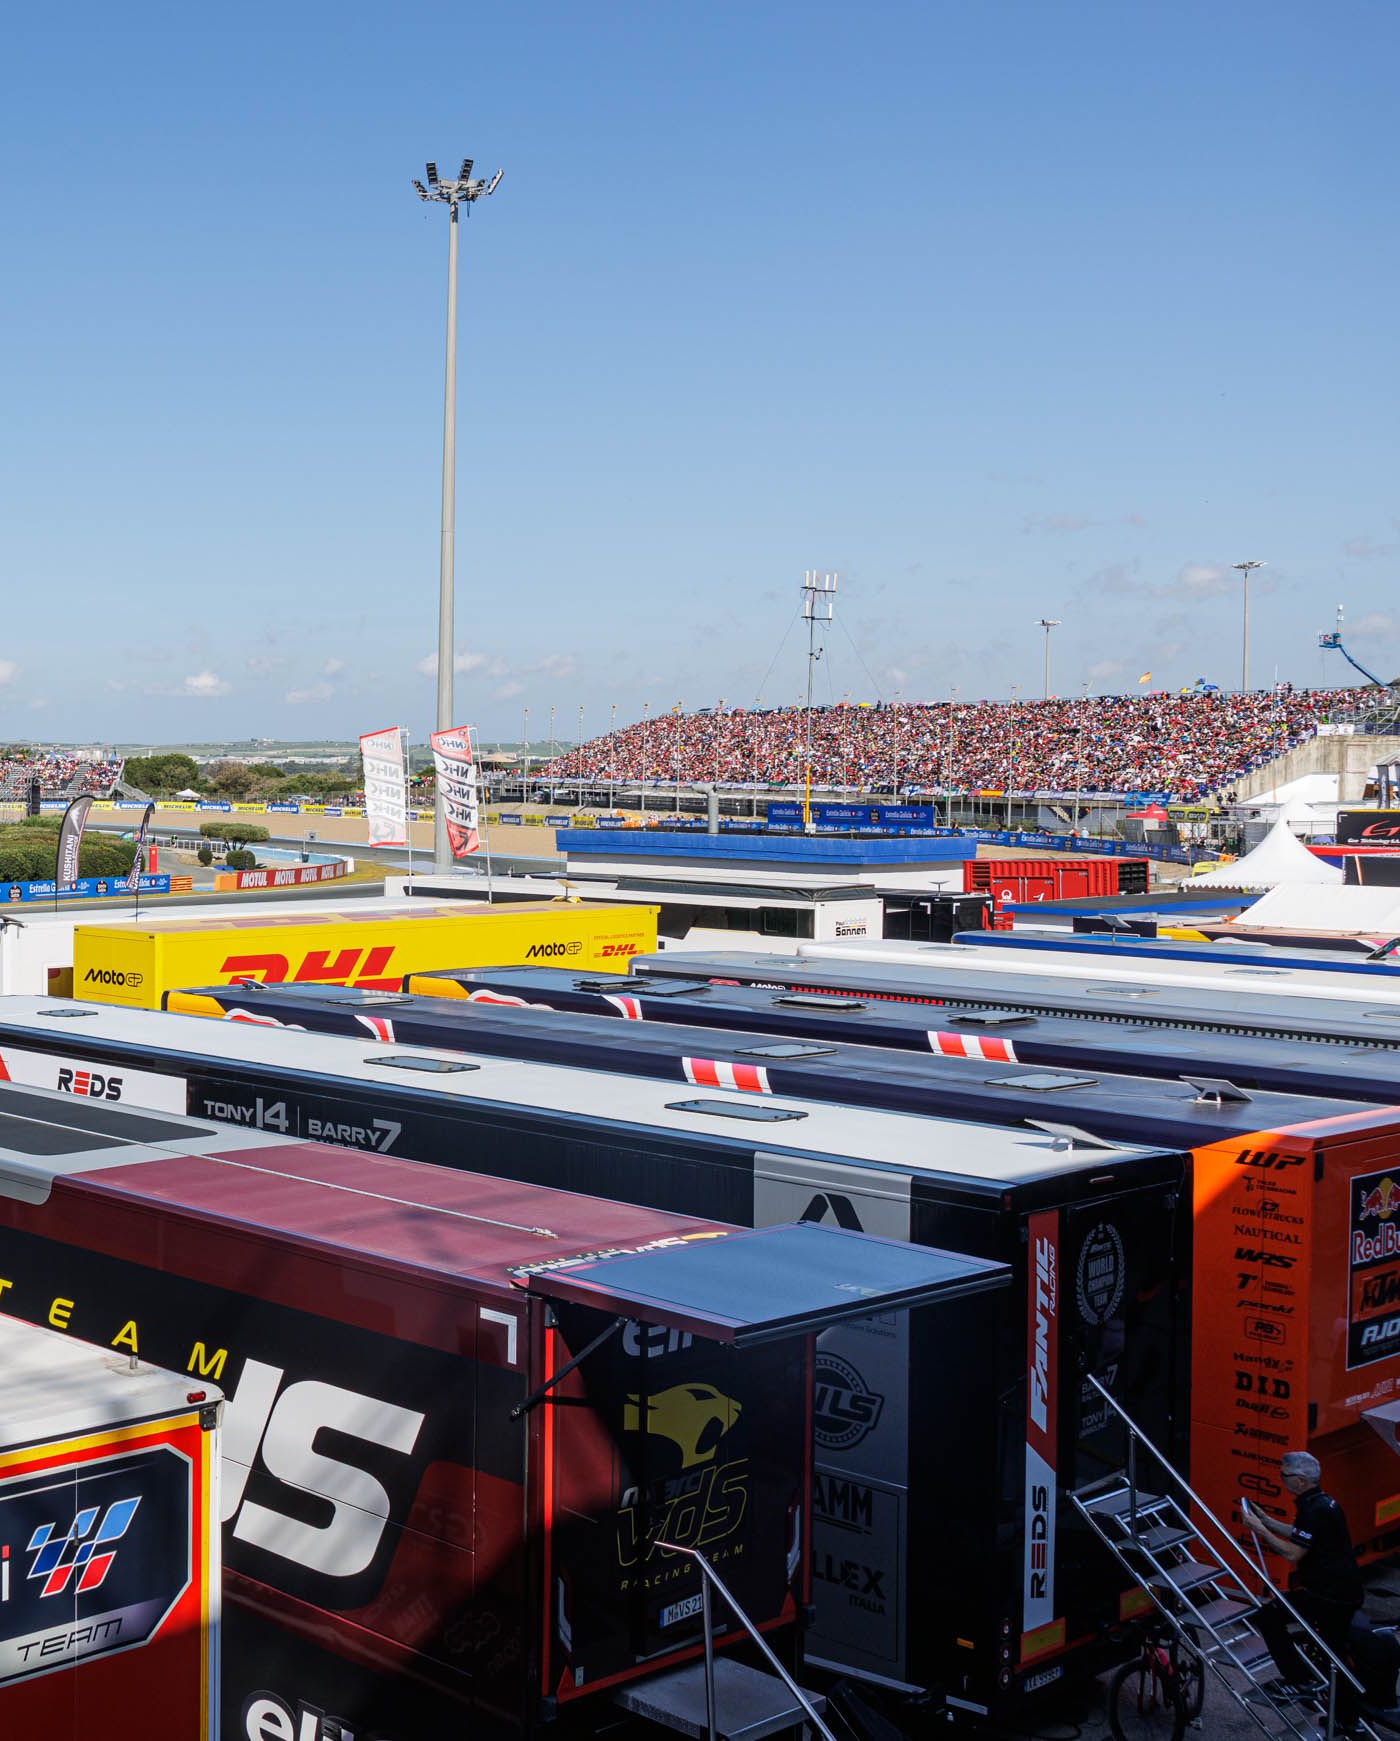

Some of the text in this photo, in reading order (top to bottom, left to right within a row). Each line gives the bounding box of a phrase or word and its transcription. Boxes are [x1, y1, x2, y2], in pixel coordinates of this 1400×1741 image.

[63, 834, 74, 881] KUSHITANI
[241, 873, 267, 888] MOTUL
[274, 871, 295, 885] MOTUL
[835, 926, 867, 937] Sannen
[602, 944, 638, 957] DHL
[219, 946, 404, 992] DHL
[57, 1068, 123, 1101] REDS
[203, 1098, 289, 1132] TONY 14
[308, 1118, 402, 1152] BARRY 7
[1235, 1149, 1306, 1170] WP
[1233, 1224, 1303, 1245] NAUTICAL
[1030, 1237, 1051, 1434] FANTIC
[1031, 1484, 1048, 1599] REDS
[18, 1617, 123, 1662] TEAM
